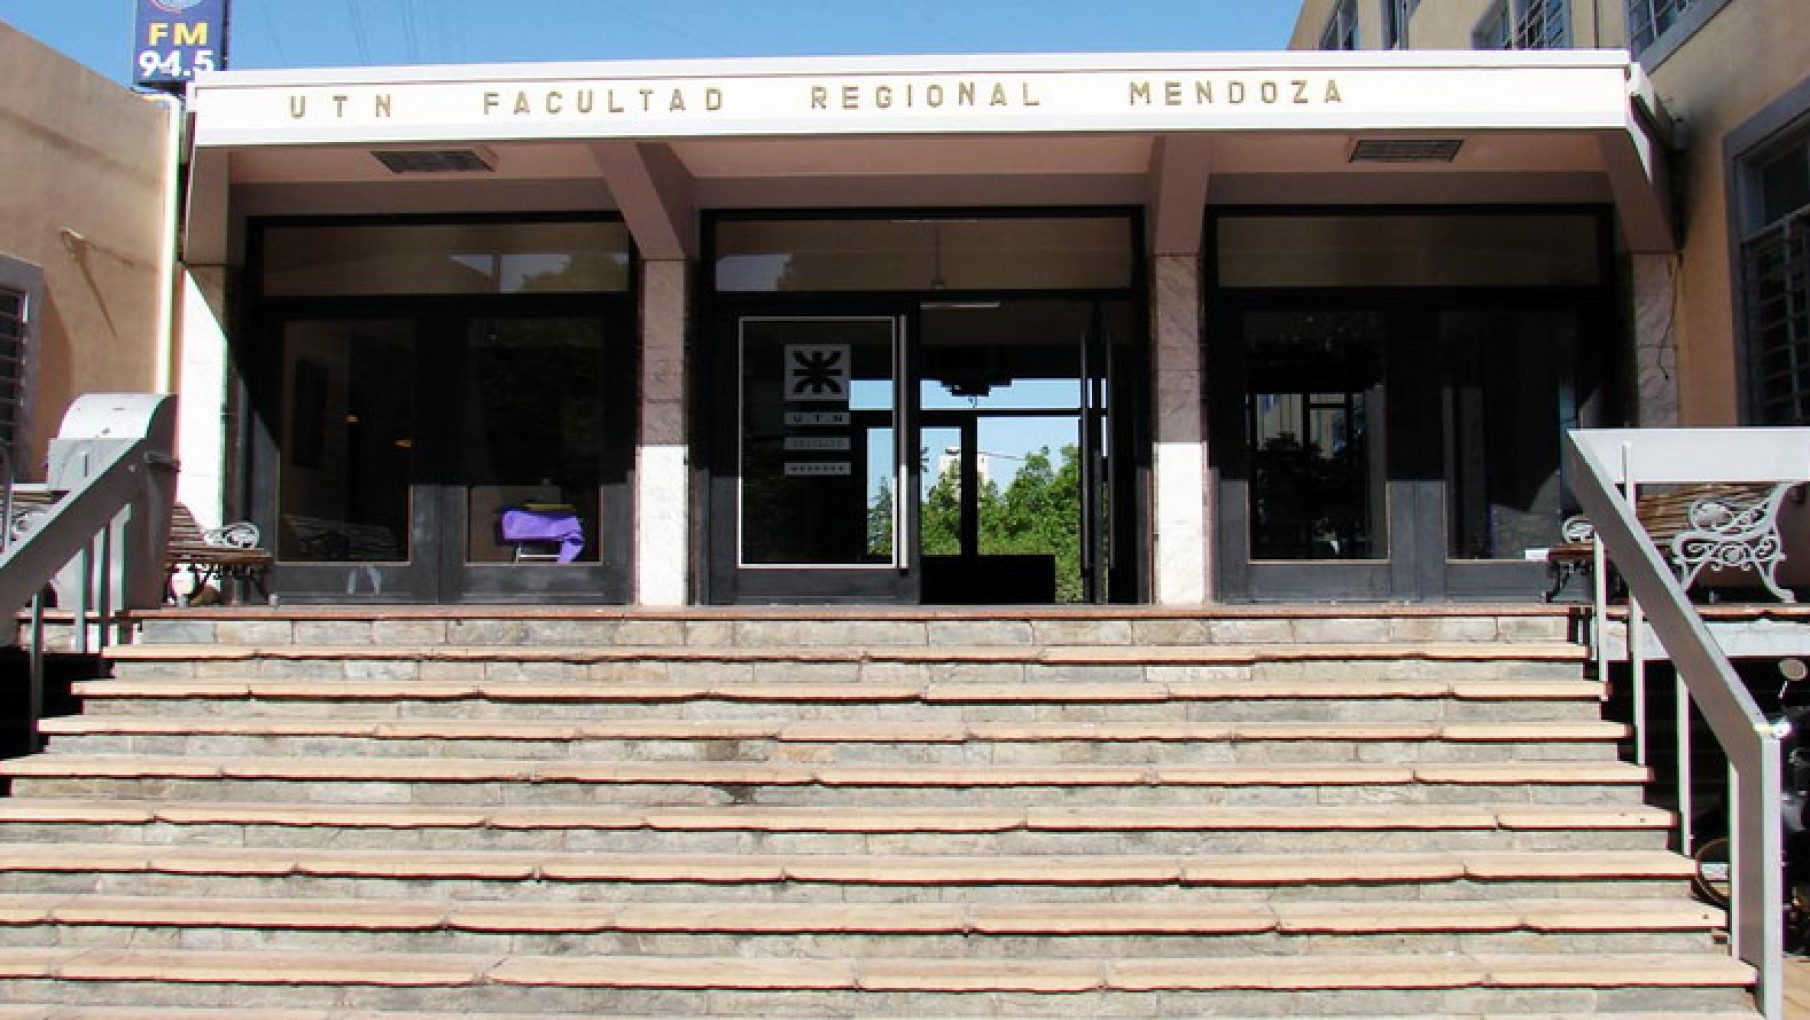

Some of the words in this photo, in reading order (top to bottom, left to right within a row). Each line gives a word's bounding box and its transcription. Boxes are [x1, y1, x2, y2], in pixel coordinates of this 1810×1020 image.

[148, 22, 208, 46] FM
[139, 50, 214, 77] 94.5
[484, 88, 723, 115] FACULTAD
[811, 82, 1040, 110] REGIONAL
[1130, 80, 1344, 106] MENDOZA
